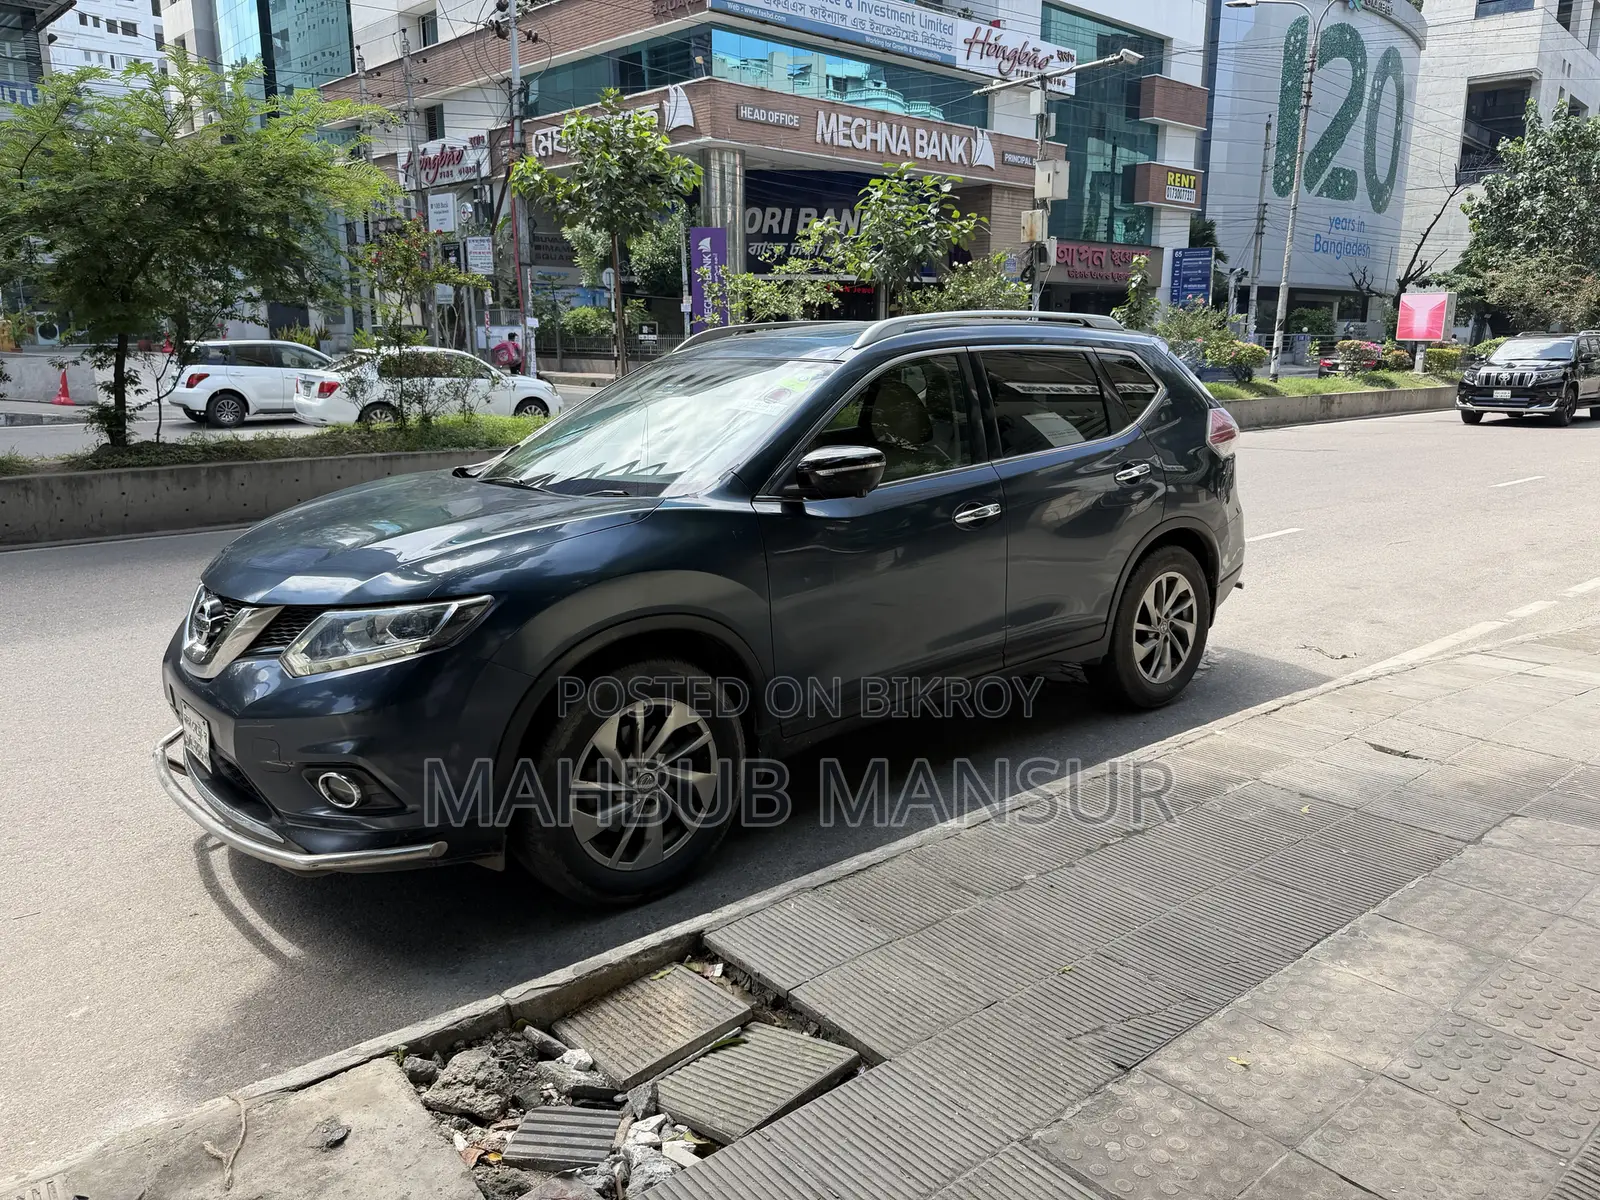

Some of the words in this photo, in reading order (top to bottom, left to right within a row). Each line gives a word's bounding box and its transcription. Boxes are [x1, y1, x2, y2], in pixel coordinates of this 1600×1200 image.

[726, 2, 740, 11] Web
[858, 0, 915, 26] Investment
[919, 15, 954, 37] Limited
[864, 36, 885, 47] Working
[892, 42, 909, 52] Growth
[740, 105, 767, 121] HEAD
[768, 110, 800, 127] OFFICE
[1272, 14, 1405, 214] 120
[815, 110, 912, 158] MEGHNA
[915, 128, 968, 165] BANK
[1004, 152, 1032, 166] PRINCIPAL
[1167, 171, 1196, 189] RENT
[745, 206, 793, 235] ORI
[796, 207, 867, 236] BAN
[1328, 216, 1356, 235] years
[1357, 216, 1365, 233] in
[1314, 233, 1370, 260] Bangladesh
